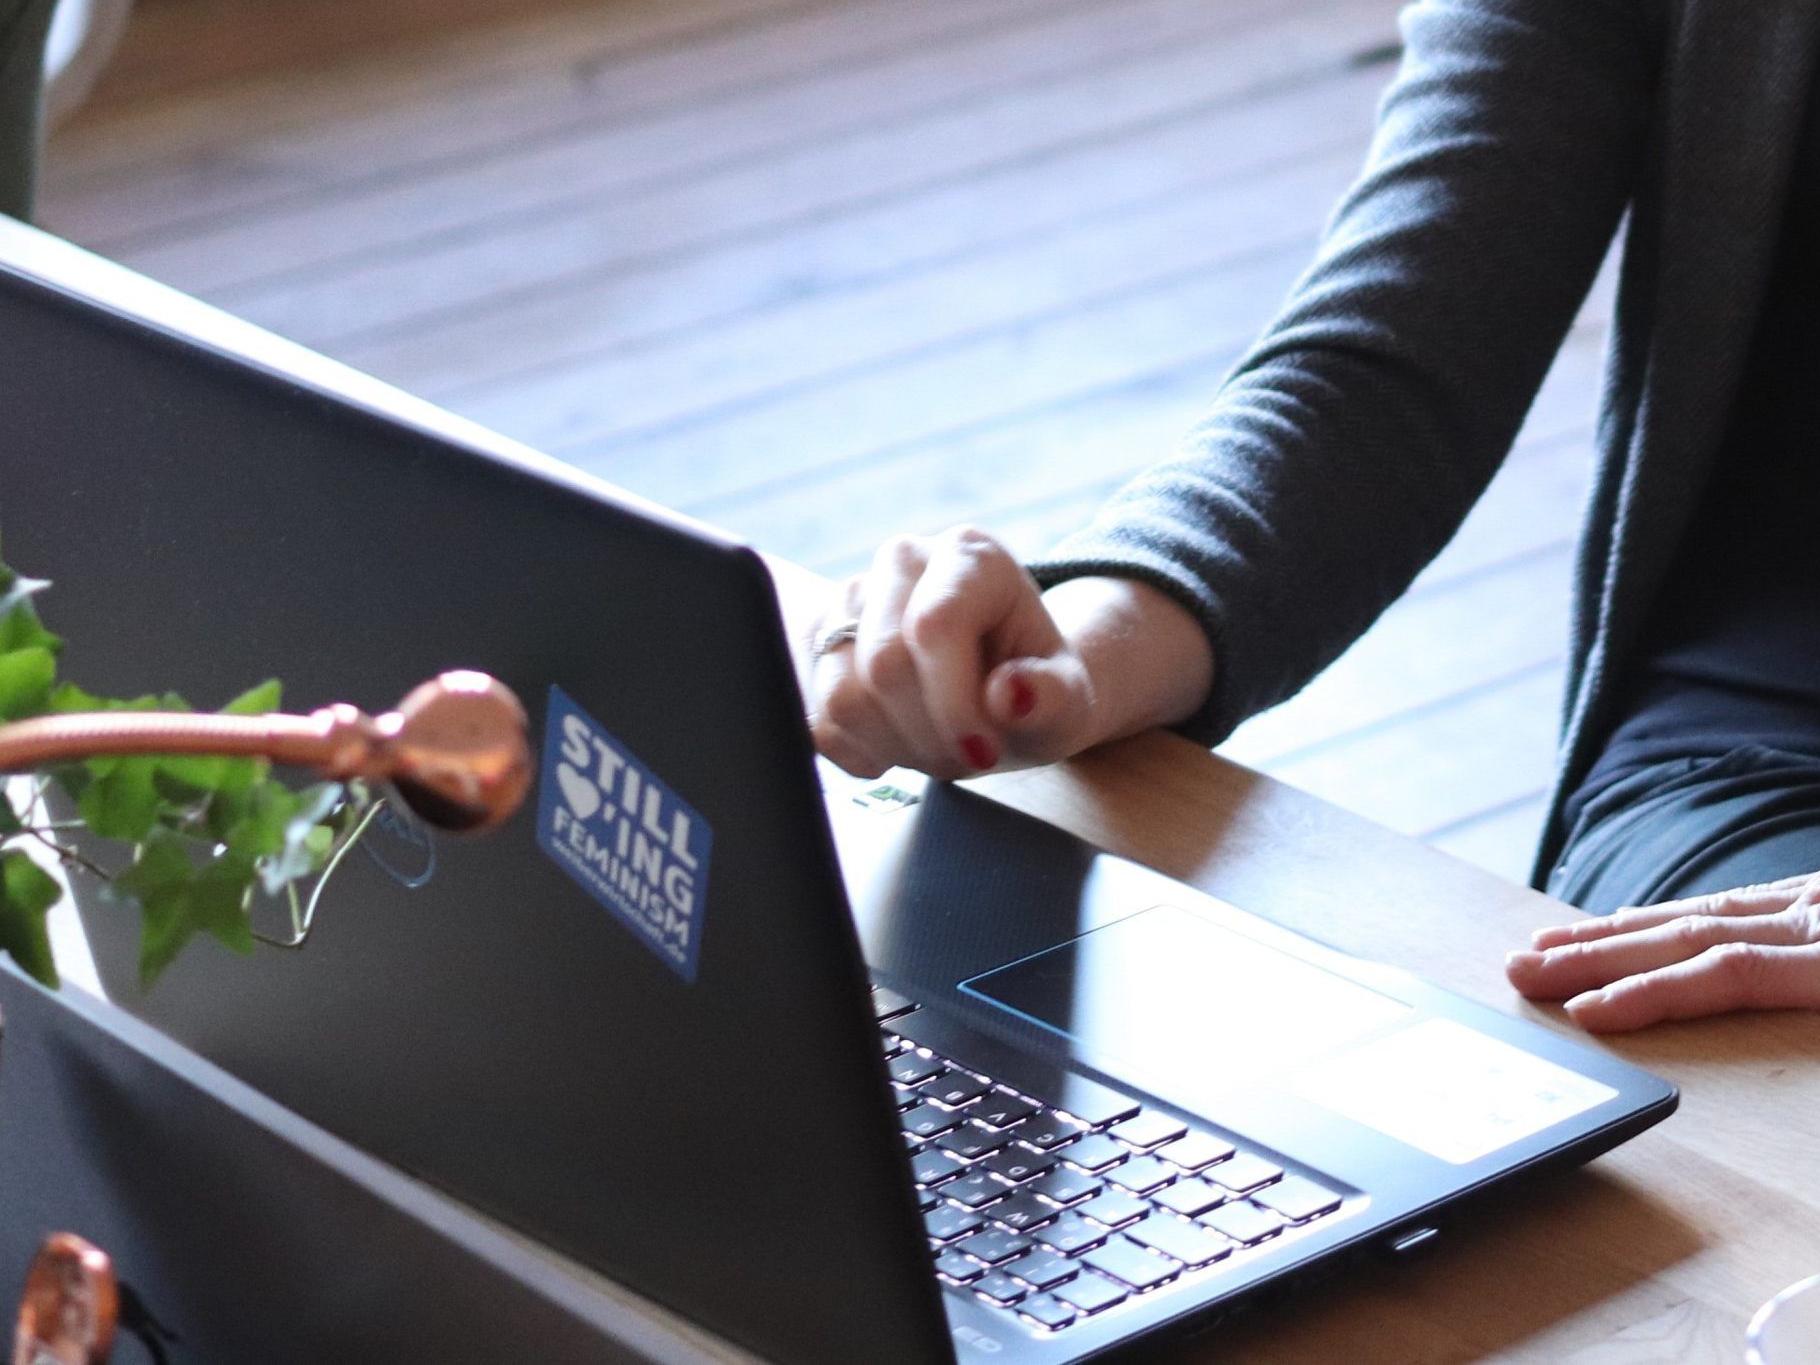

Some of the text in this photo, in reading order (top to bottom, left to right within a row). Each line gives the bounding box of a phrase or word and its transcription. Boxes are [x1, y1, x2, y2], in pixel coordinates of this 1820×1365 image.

[561, 714, 698, 871] STILL
[553, 806, 690, 947] FEMINISM
[988, 1112, 1007, 1122] V
[1005, 1212, 1030, 1224] W
